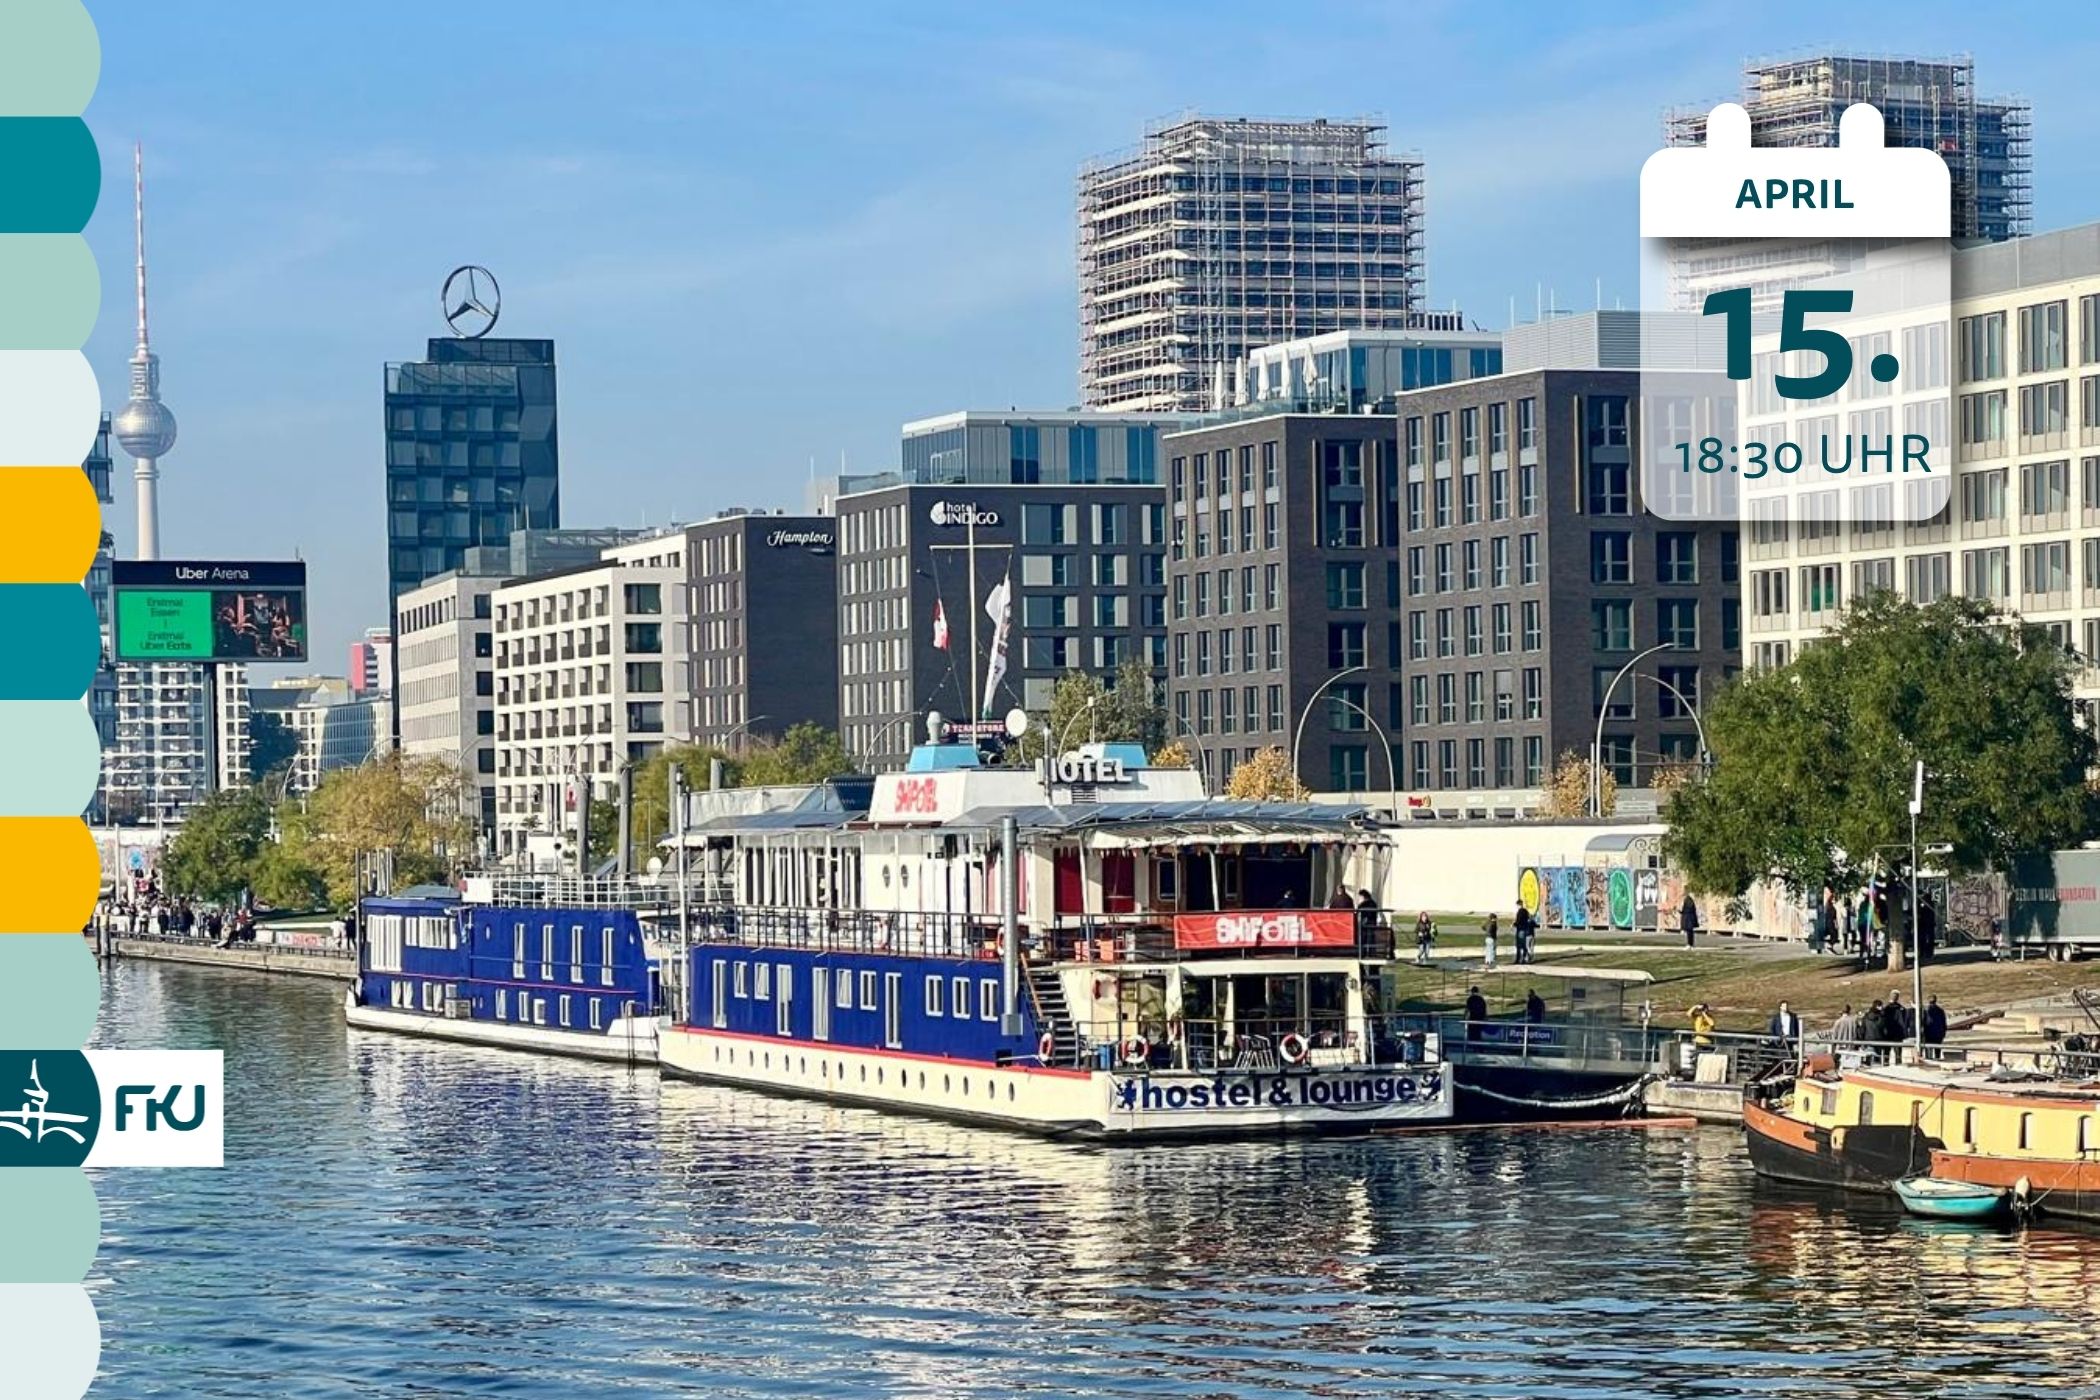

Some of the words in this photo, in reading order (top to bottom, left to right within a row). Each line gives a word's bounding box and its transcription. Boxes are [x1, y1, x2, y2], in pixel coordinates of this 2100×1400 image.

[947, 502, 977, 512] hotel
[947, 512, 999, 524] INDIGO
[767, 530, 833, 546] Hampton
[175, 566, 208, 579] Uber
[211, 567, 249, 579] Arena
[1142, 1076, 1262, 1108] hostel
[1268, 1076, 1293, 1106] &
[1300, 1073, 1417, 1104] lounge
